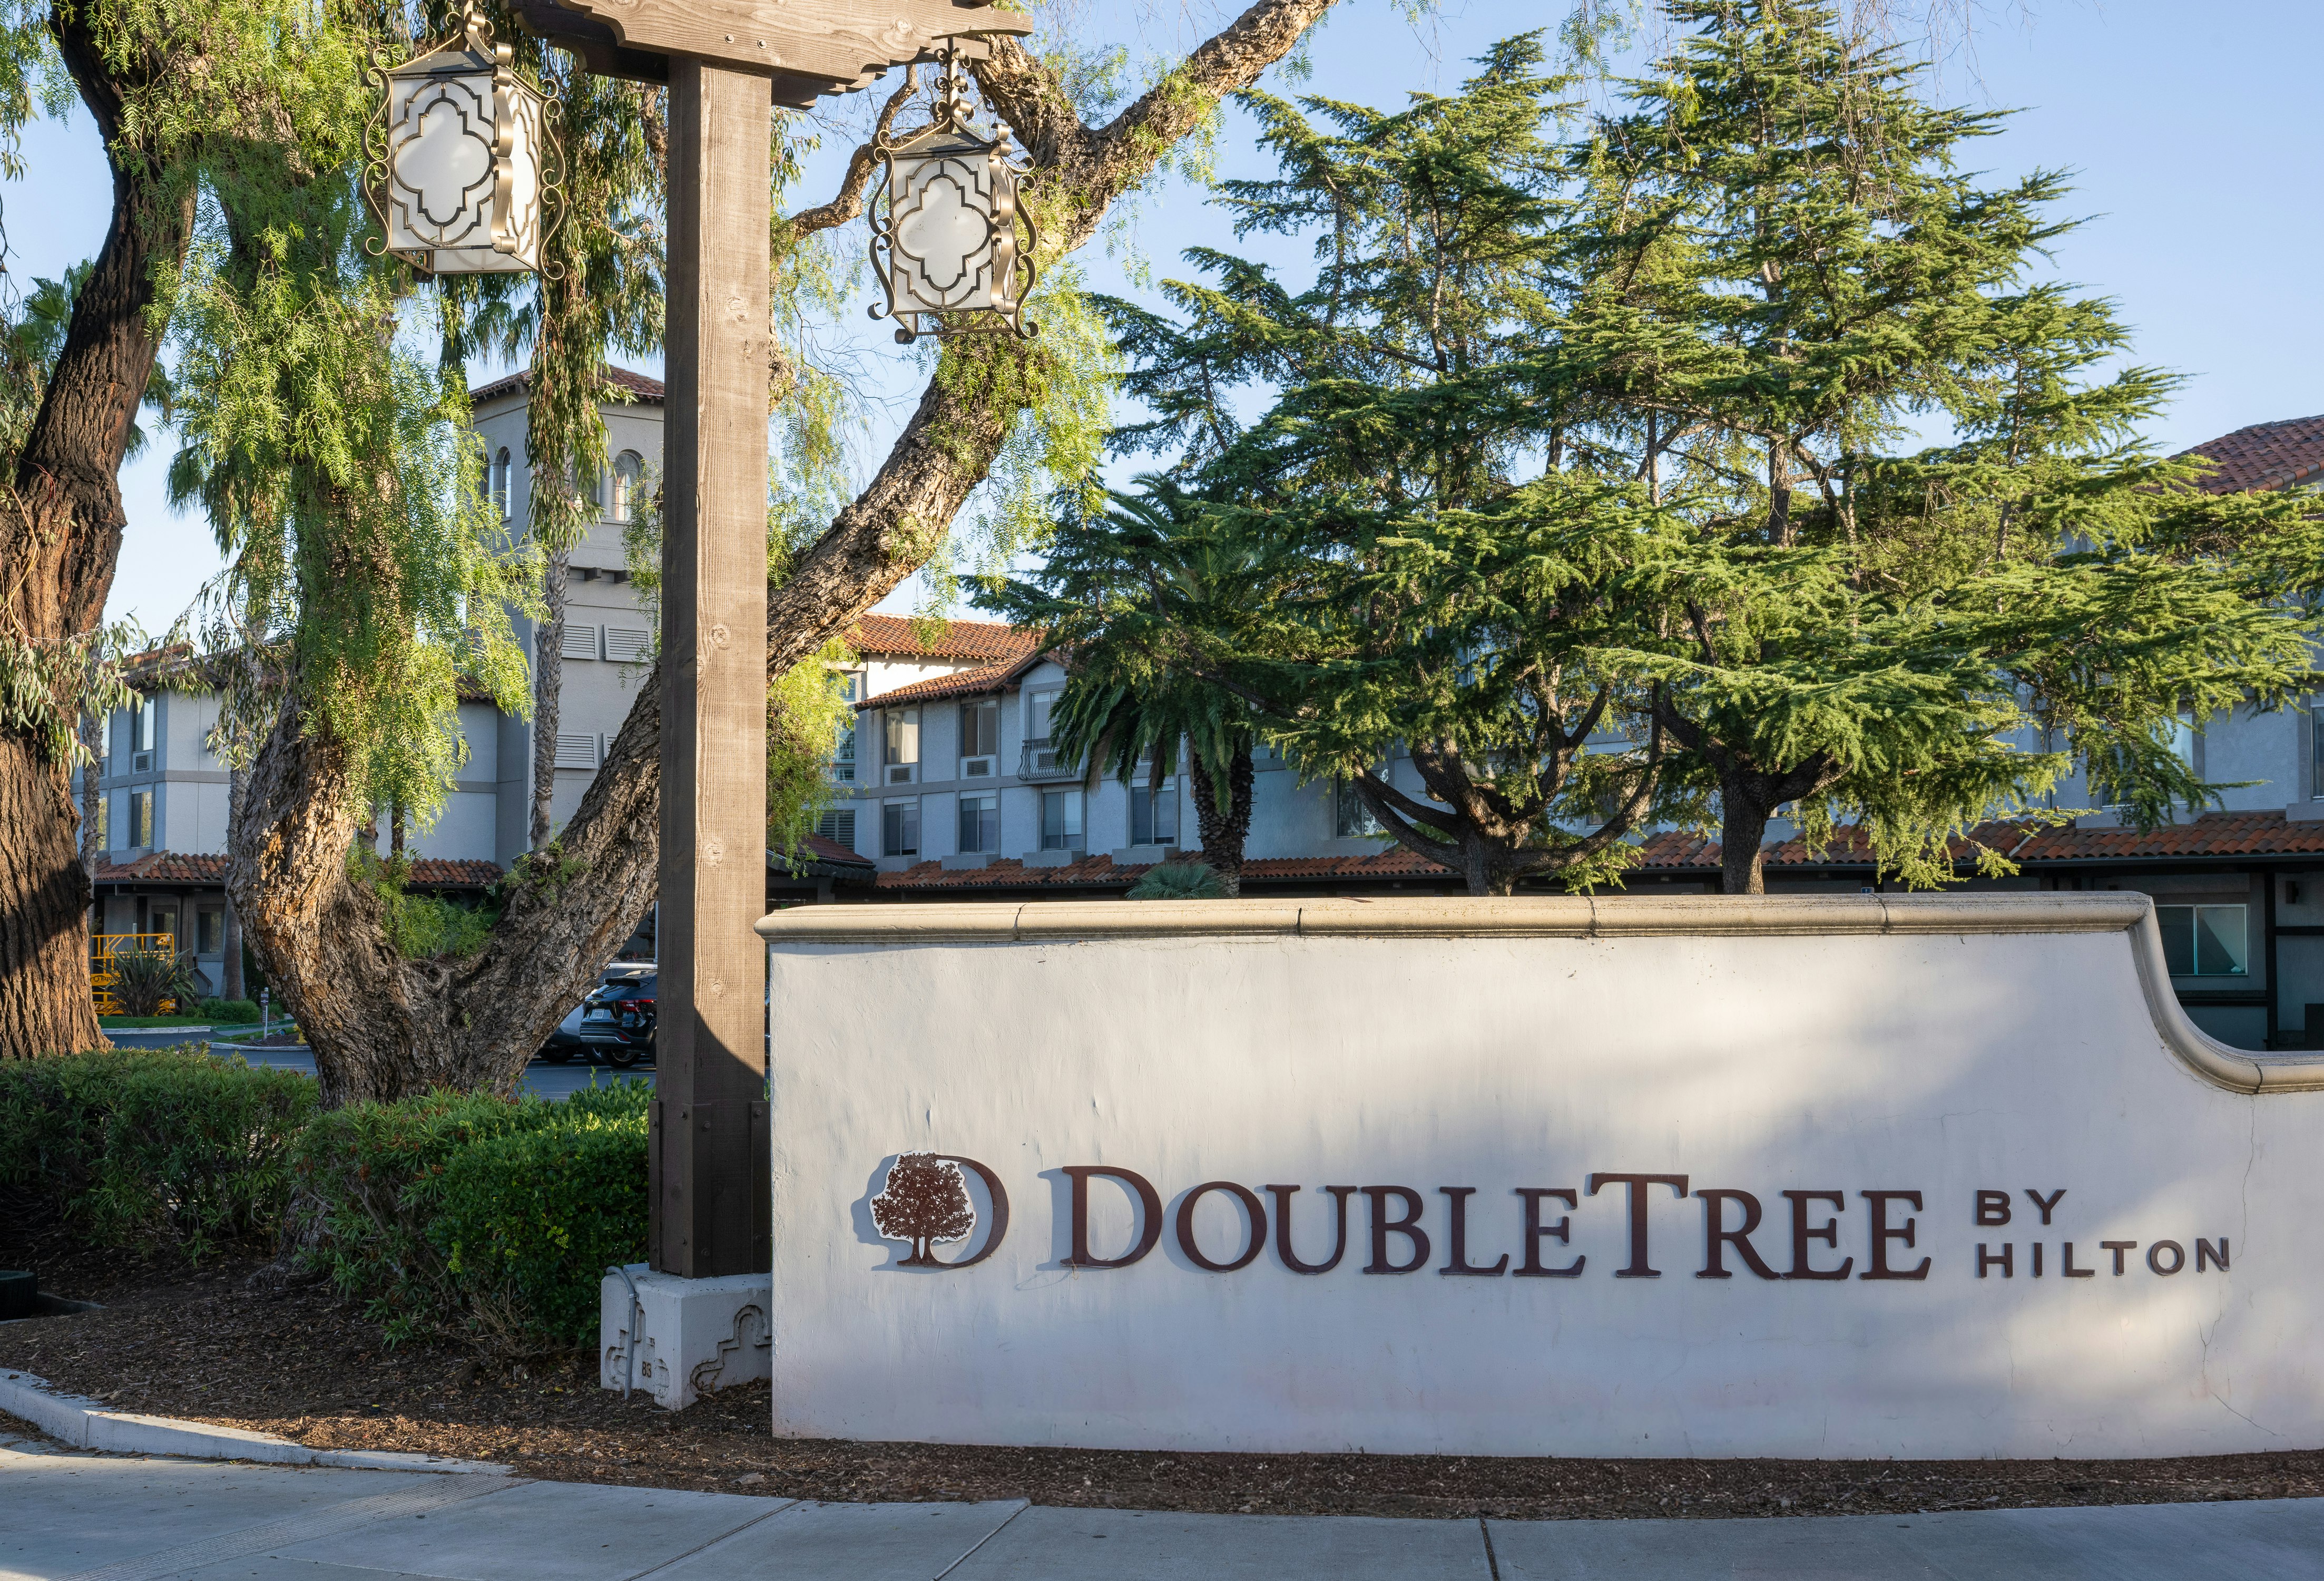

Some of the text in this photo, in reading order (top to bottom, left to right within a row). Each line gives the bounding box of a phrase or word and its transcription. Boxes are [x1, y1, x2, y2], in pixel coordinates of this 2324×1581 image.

[1060, 1166, 1932, 1281] DOUBLETREE
[1976, 1189, 2067, 1227] BY
[1978, 1238, 2230, 1279] HILTON
[642, 1361, 652, 1378] 83
